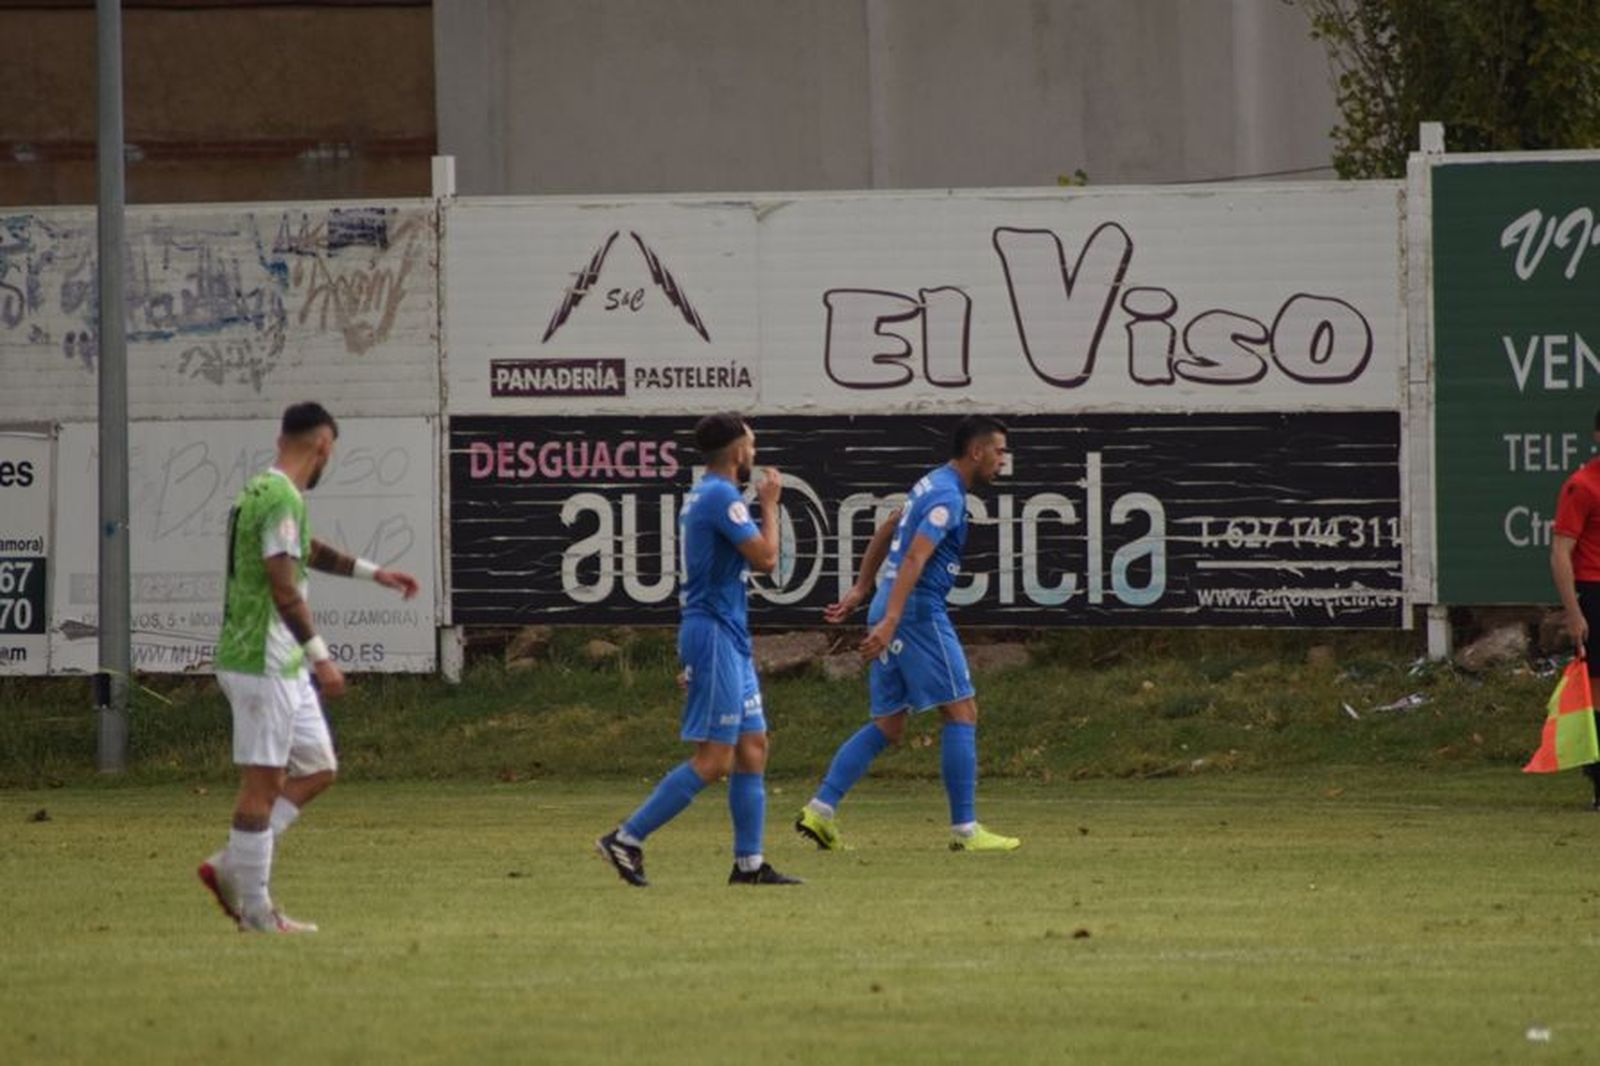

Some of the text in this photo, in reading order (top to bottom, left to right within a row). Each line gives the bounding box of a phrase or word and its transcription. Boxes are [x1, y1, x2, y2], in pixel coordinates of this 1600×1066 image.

[823, 286, 971, 388] El
[496, 361, 752, 391] PANADERÍA PASTELERÍA
[469, 442, 679, 478] DESGUACES
[1226, 517, 1284, 548] 627
[1348, 516, 1399, 548] 311
[1504, 506, 1556, 546] Ctr
